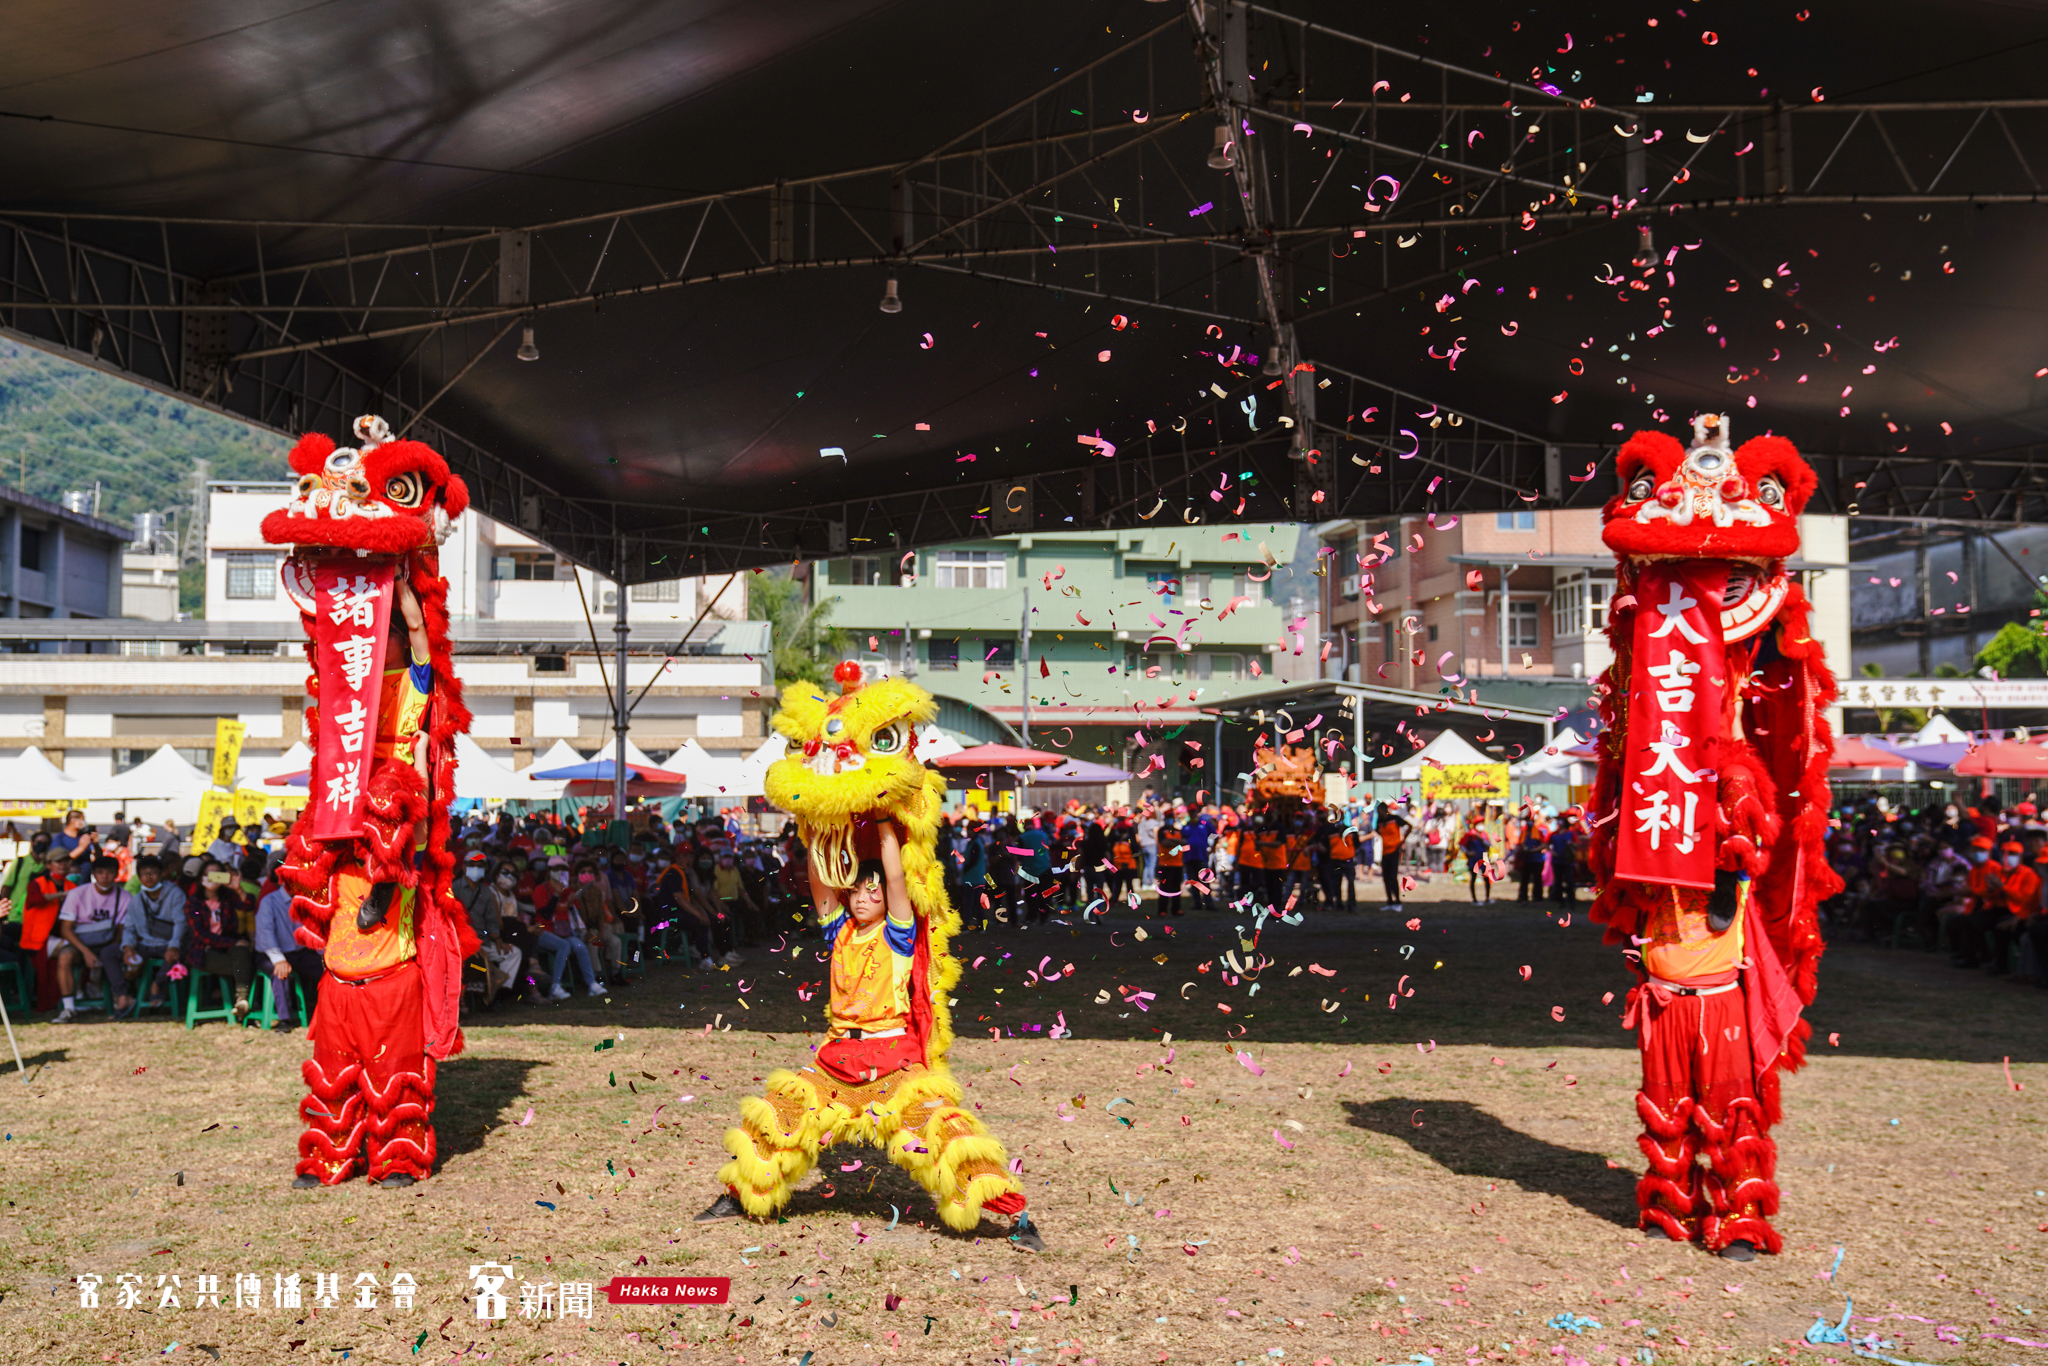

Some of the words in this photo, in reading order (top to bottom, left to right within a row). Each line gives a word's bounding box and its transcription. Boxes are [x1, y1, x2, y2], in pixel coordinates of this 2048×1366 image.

[326, 575, 380, 814] 諸事吉祥
[1634, 582, 1708, 855] 大吉大利
